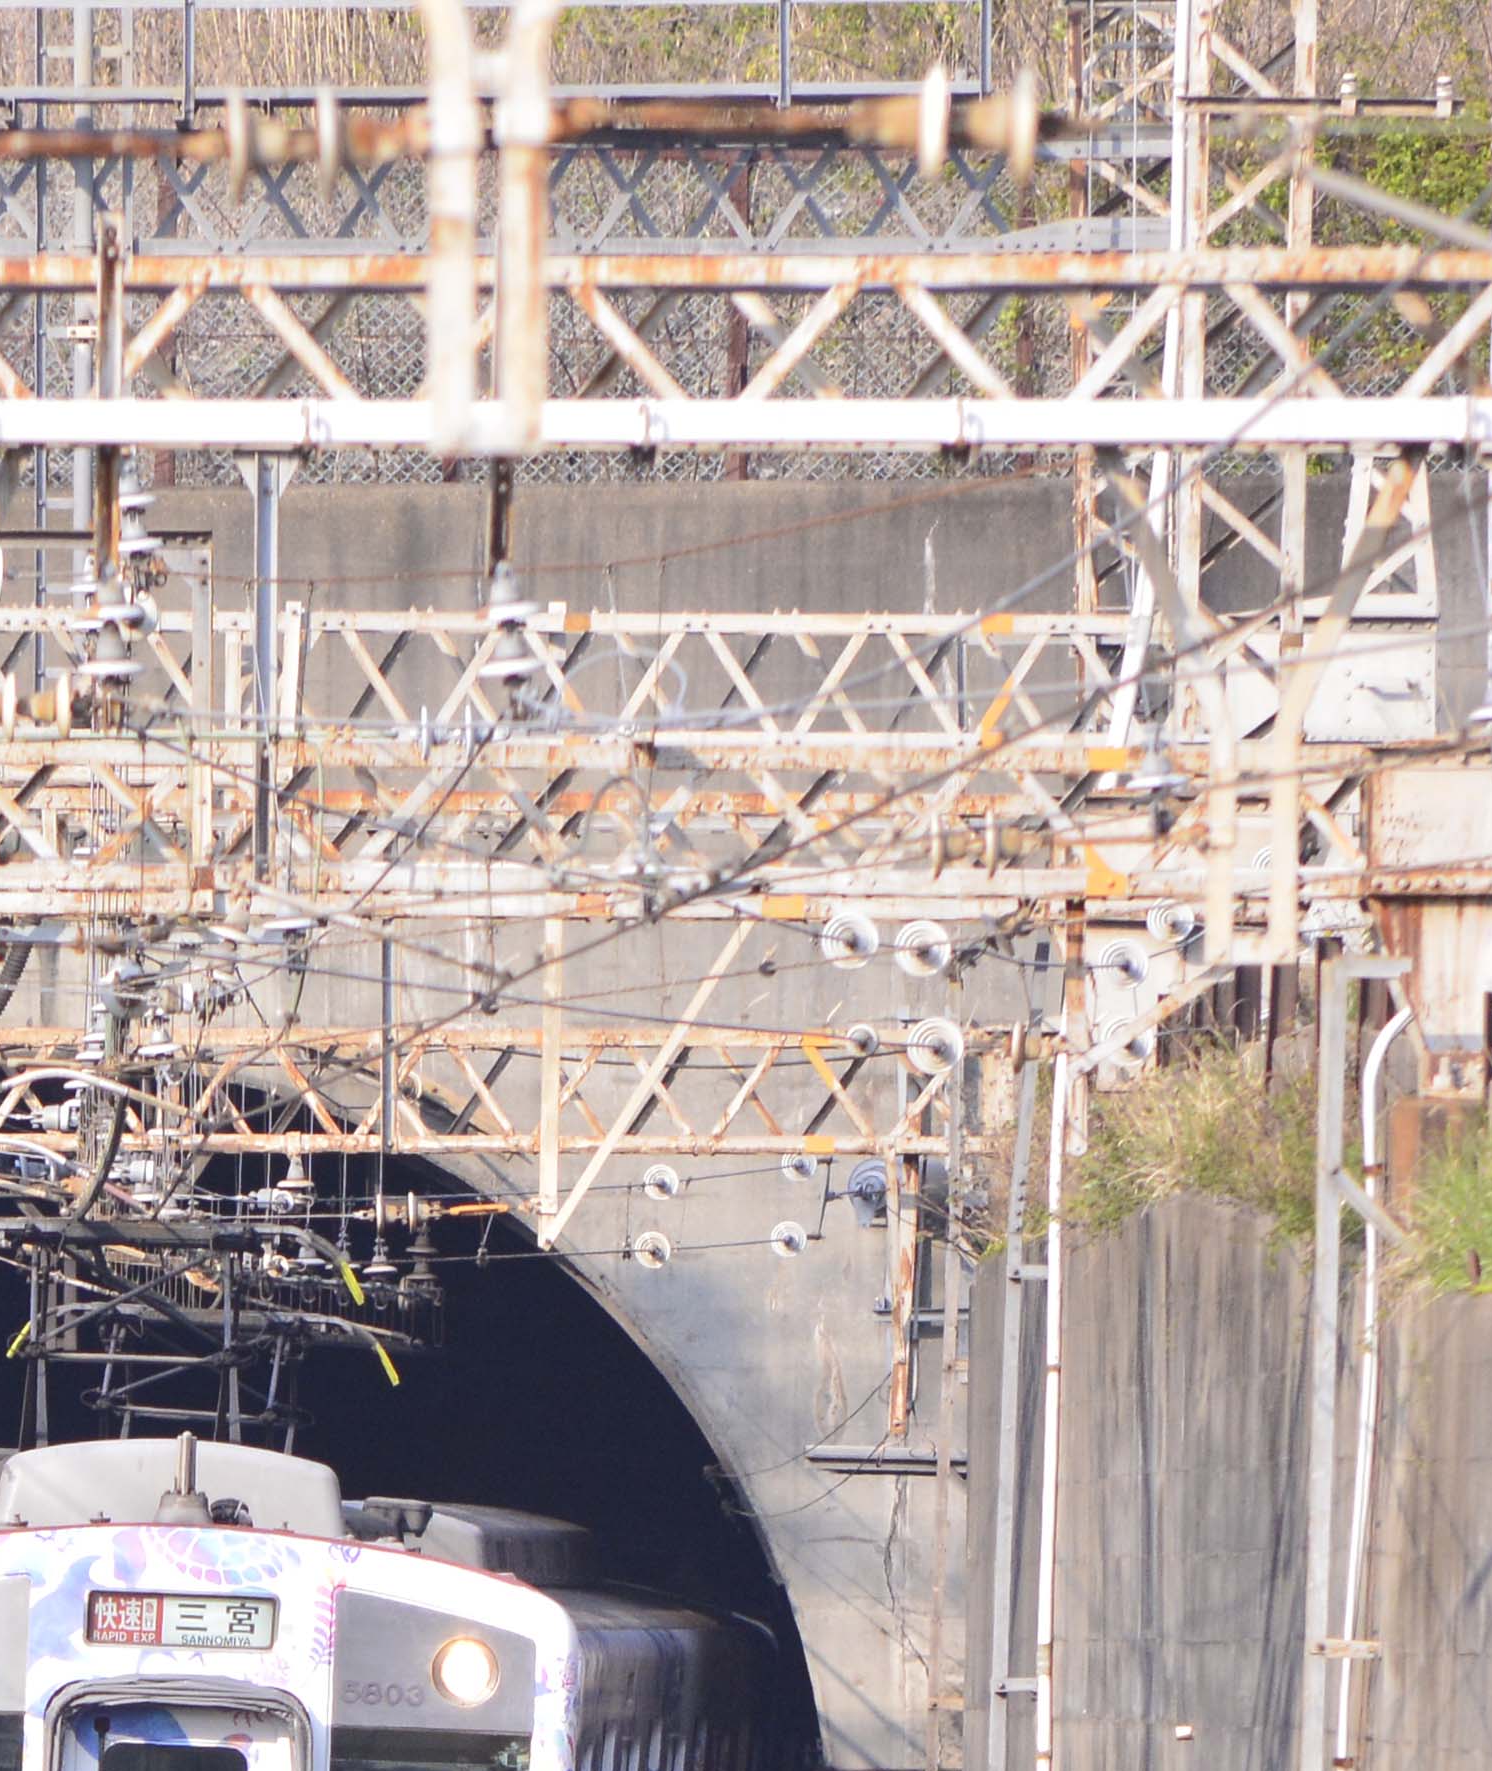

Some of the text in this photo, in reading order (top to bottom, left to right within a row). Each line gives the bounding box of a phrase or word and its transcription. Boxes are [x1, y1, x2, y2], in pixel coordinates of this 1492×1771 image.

[175, 1602, 260, 1634] 三宮
[93, 1630, 127, 1642] RAPID
[181, 1634, 251, 1648] SANNOMIYA
